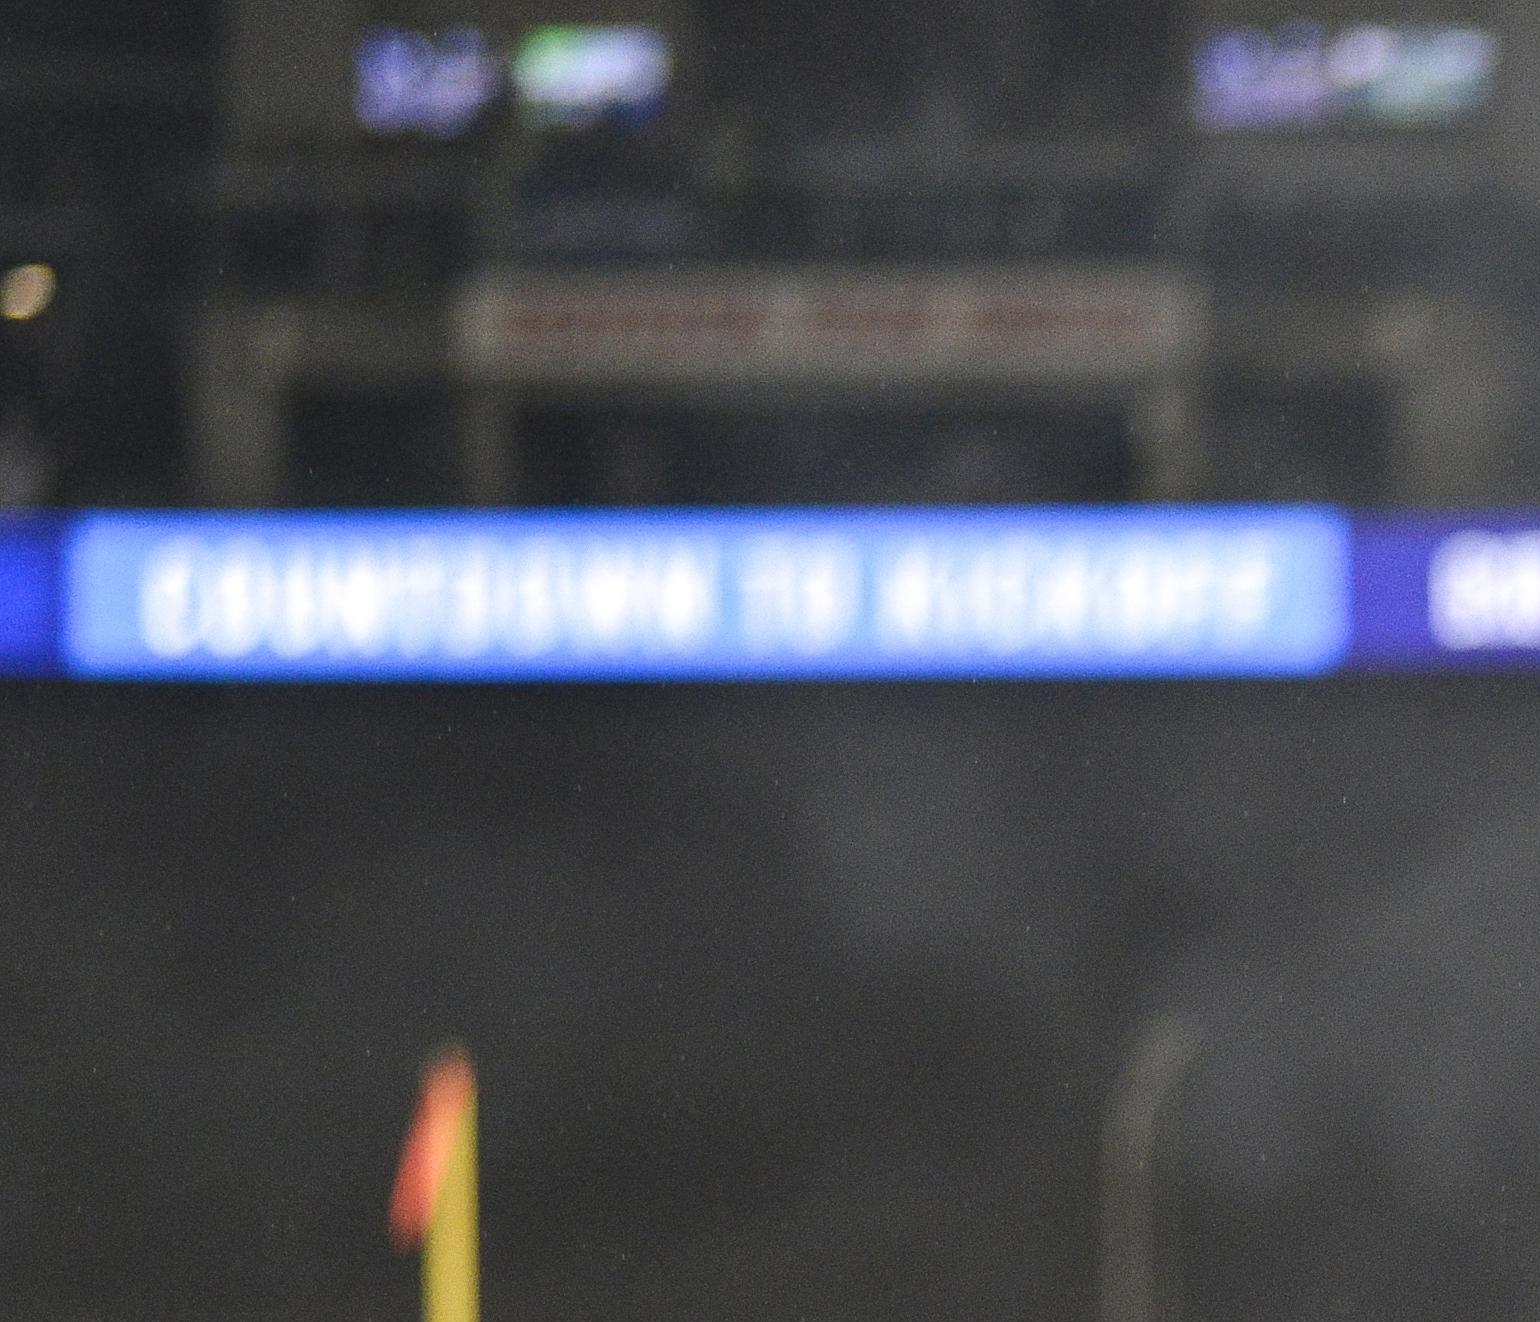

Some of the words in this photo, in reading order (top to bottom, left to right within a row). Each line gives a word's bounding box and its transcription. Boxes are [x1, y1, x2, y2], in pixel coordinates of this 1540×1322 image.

[142, 527, 717, 656] COUNTDOWN
[735, 528, 858, 652] TO
[879, 523, 1277, 650] KICKOFF
